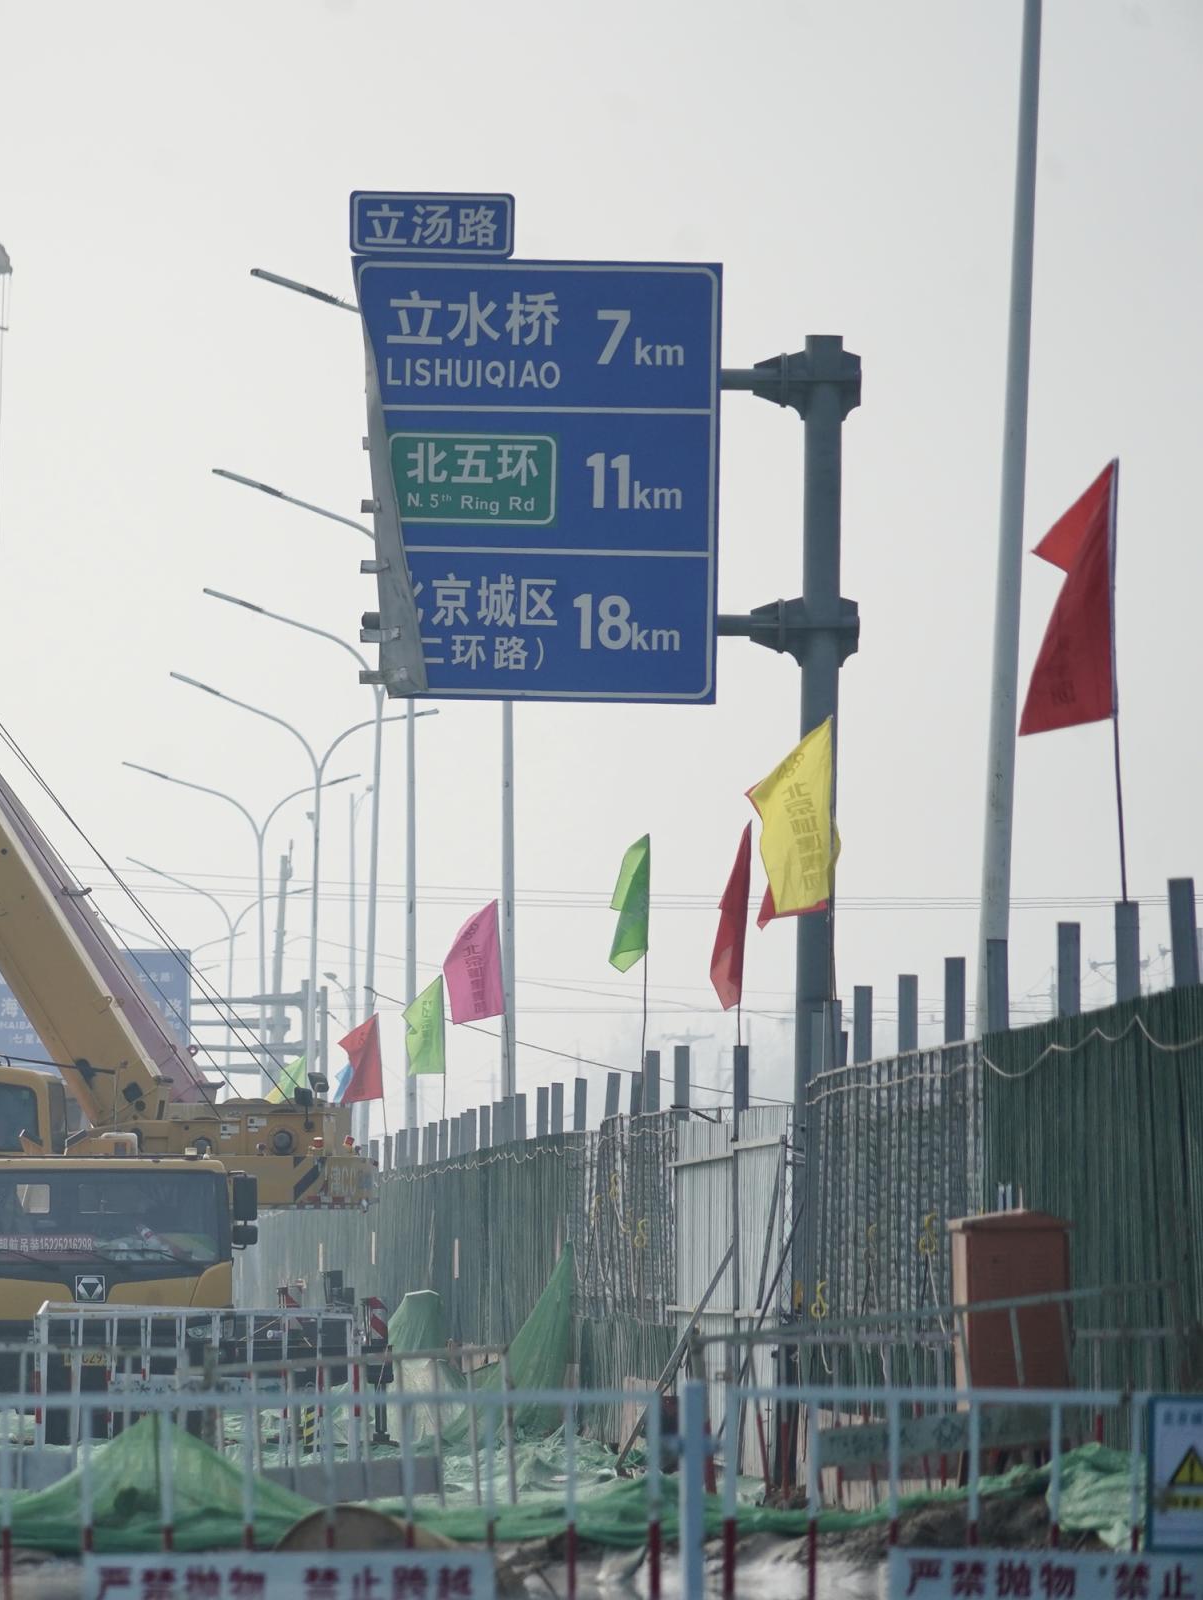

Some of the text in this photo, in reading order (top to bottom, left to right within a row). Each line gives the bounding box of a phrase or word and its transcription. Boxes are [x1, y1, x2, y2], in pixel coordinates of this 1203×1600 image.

[364, 203, 497, 247] 立汤路
[386, 290, 560, 347] 立水桥
[386, 358, 561, 389] LISHUIQIAO
[406, 442, 683, 510] 北五环 11km
[407, 492, 535, 515] N. 5th Ring Rd
[573, 592, 681, 652] 18km
[906, 1557, 1077, 1598] 严禁抛物
